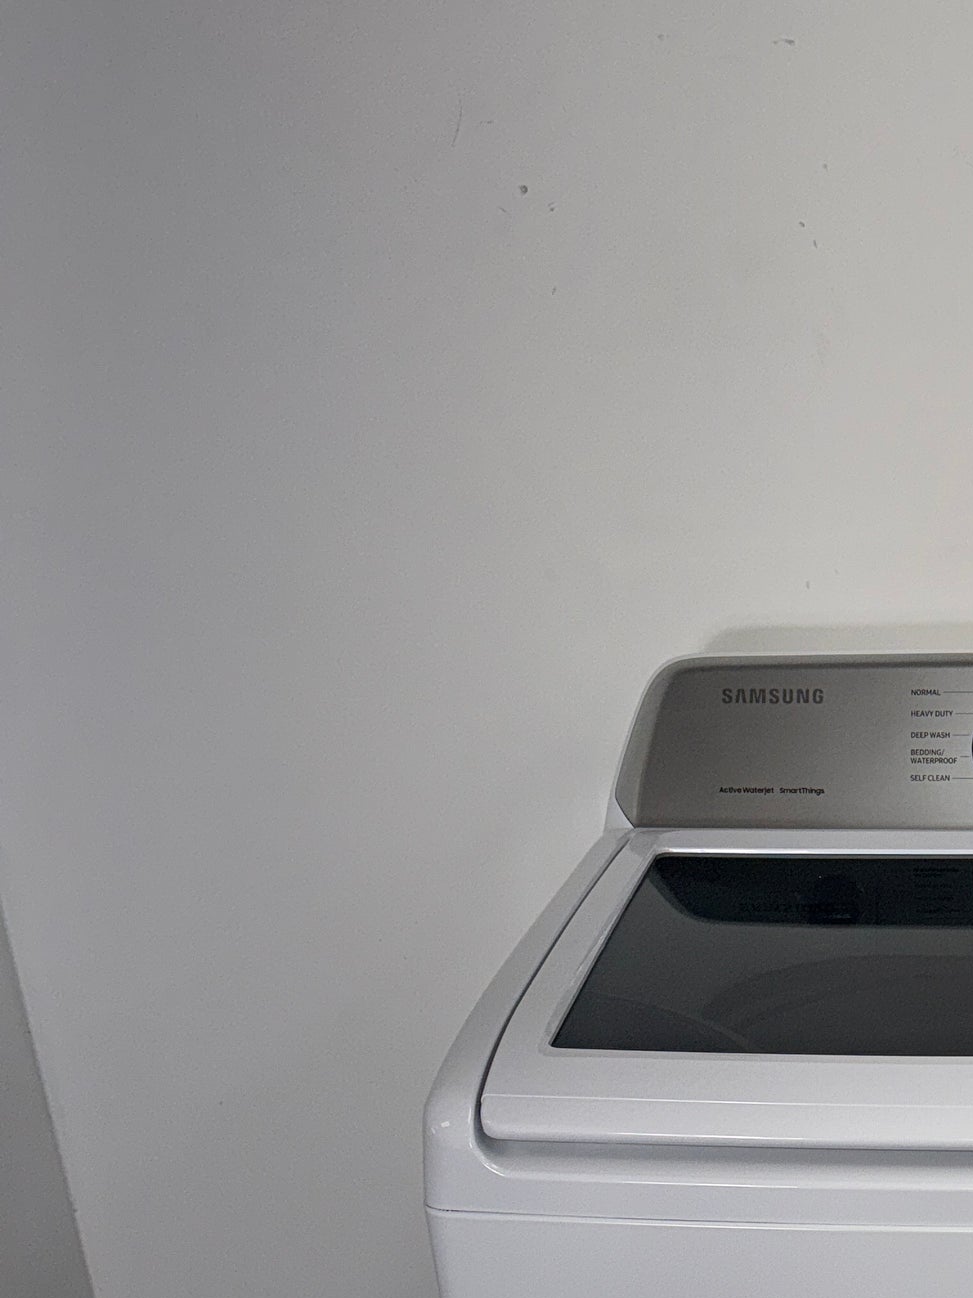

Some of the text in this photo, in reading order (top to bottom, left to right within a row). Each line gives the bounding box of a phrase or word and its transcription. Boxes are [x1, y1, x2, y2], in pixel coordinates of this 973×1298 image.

[722, 688, 825, 704] SAMSUNG
[911, 749, 945, 757] BEDDING/
[779, 787, 825, 796] SmartThings
